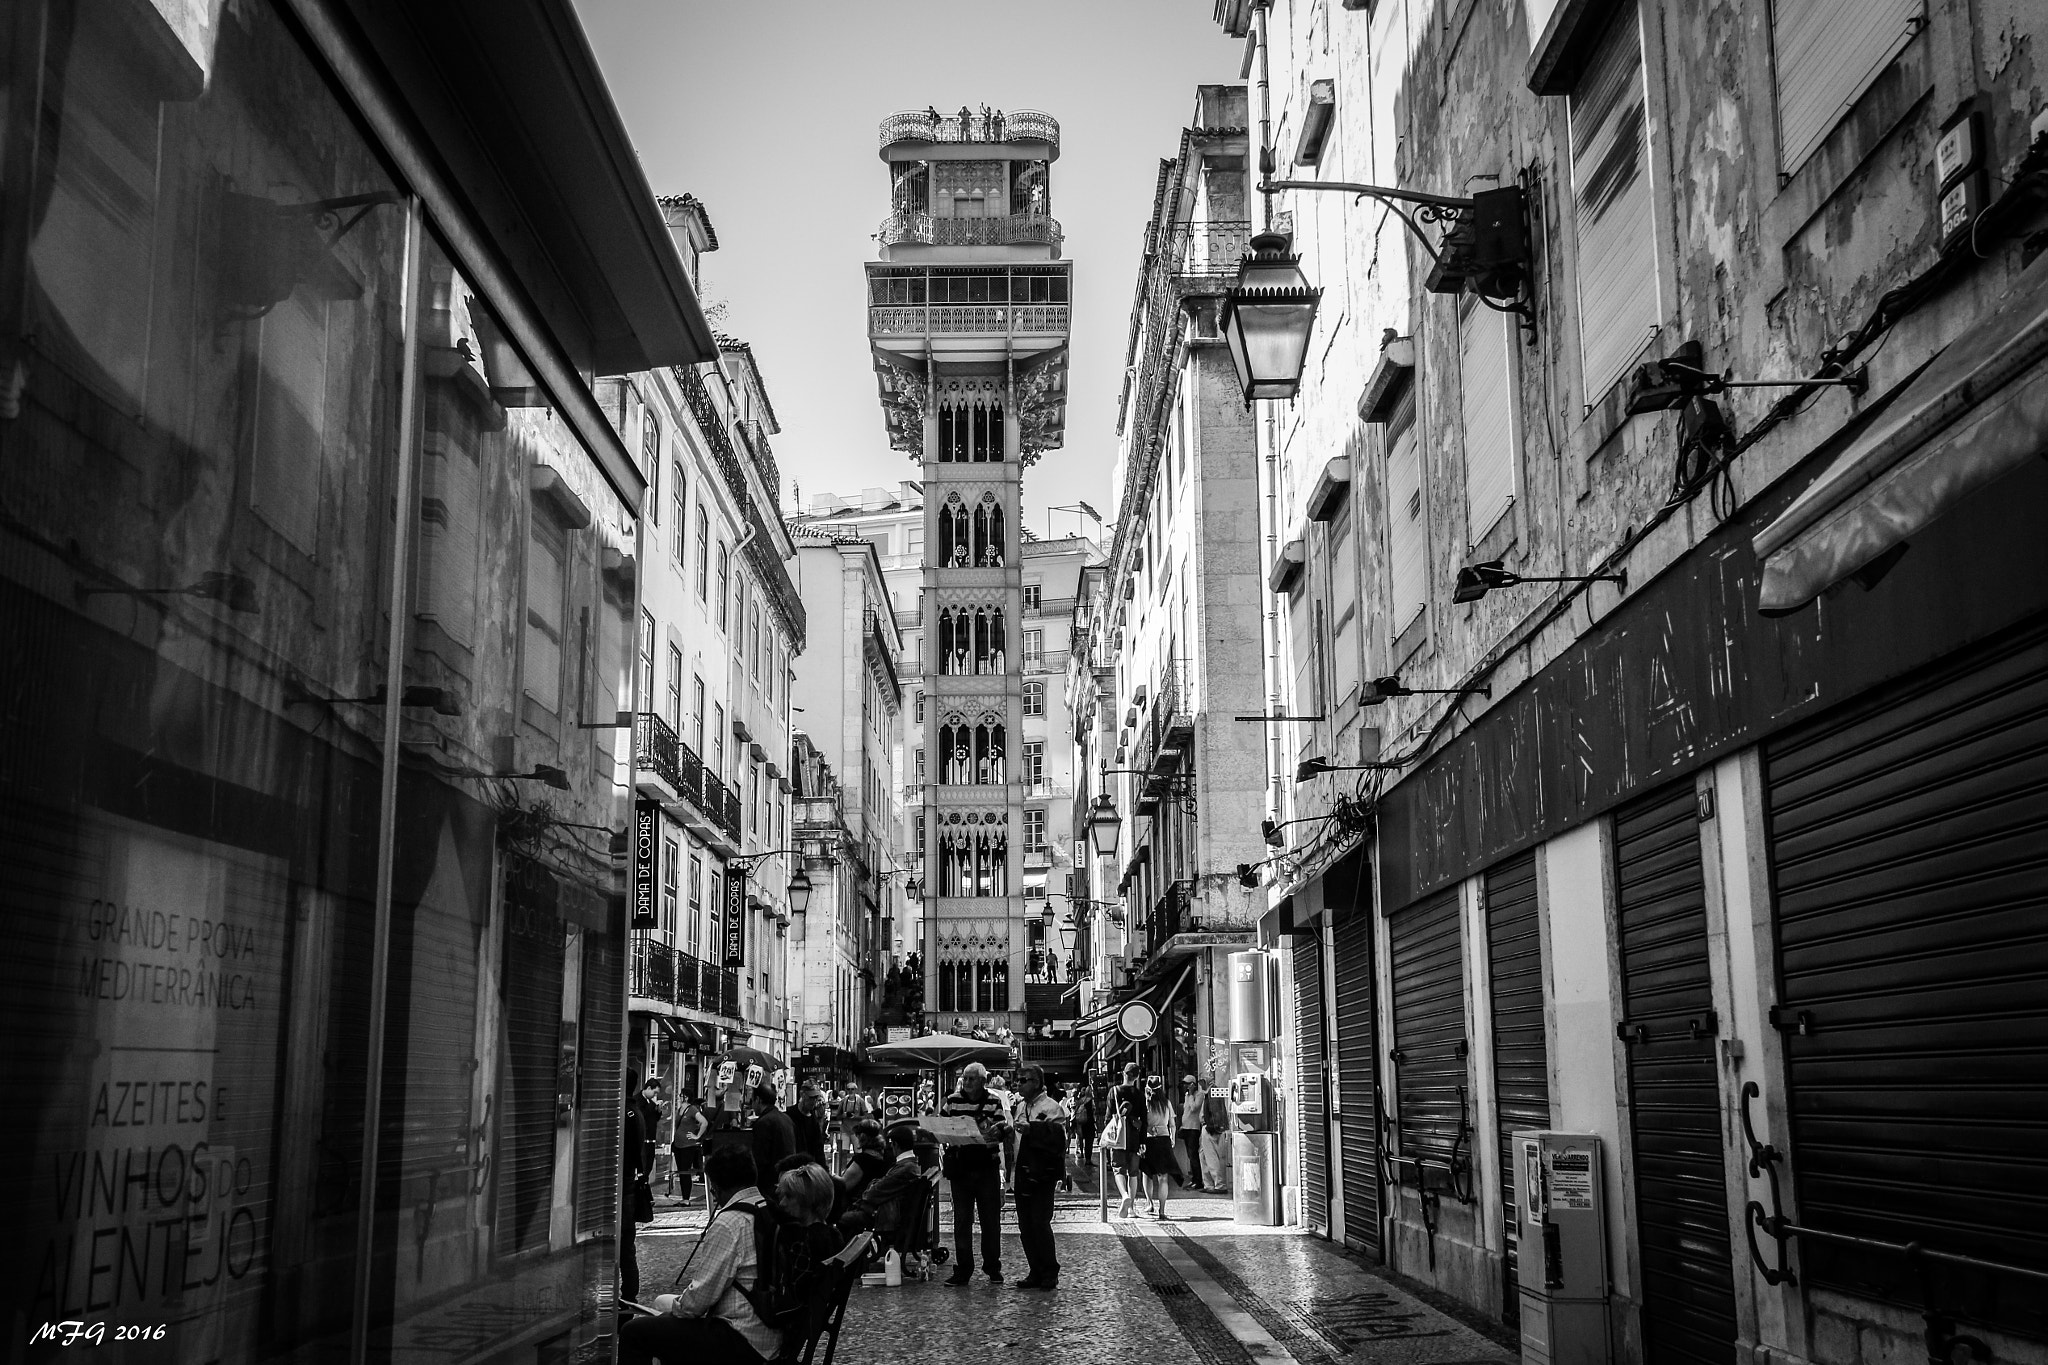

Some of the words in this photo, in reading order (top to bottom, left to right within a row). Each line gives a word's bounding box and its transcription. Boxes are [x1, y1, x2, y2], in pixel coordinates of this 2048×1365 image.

[638, 862, 650, 878] DE
[638, 882, 650, 915] DAMA
[88, 899, 180, 952] GRANDE
[186, 917, 255, 961] PROVA
[729, 932, 738, 957] DAMA
[730, 917, 739, 929] DE
[78, 956, 256, 1010] MEDITERRÂNICA
[91, 1081, 207, 1128] AZEITES
[215, 1087, 227, 1122] E
[54, 1140, 210, 1222] VINHOS
[218, 1157, 252, 1198] DO
[30, 1205, 257, 1324] ALENTEJO
